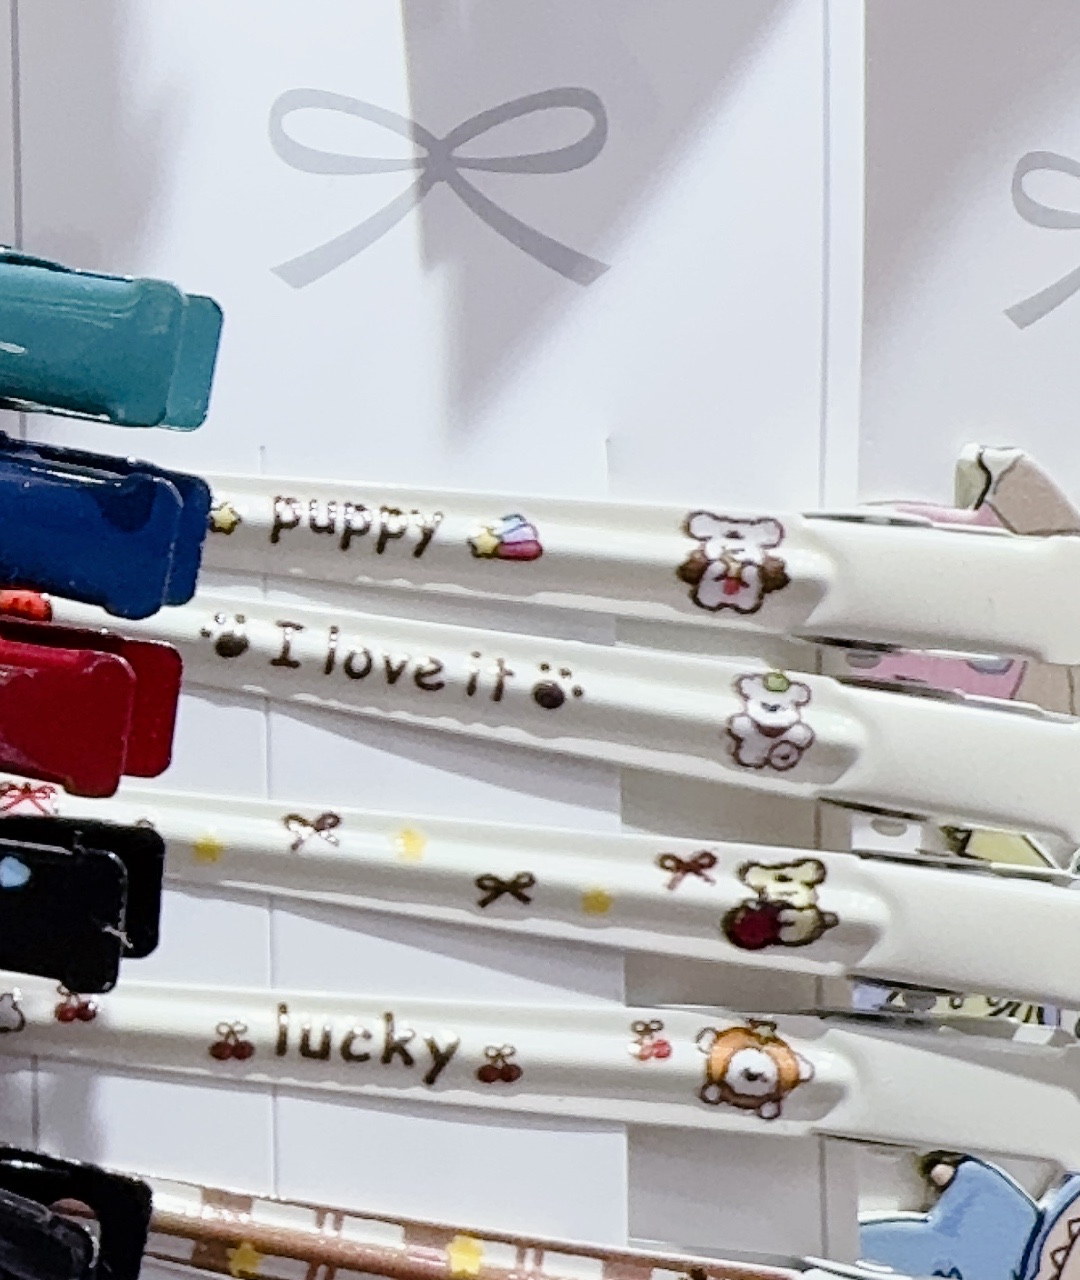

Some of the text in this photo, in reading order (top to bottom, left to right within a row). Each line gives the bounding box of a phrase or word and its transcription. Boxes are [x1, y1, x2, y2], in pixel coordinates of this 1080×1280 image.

[271, 495, 445, 559] puppy
[271, 621, 514, 702] I love it
[274, 1001, 461, 1086] lucky
